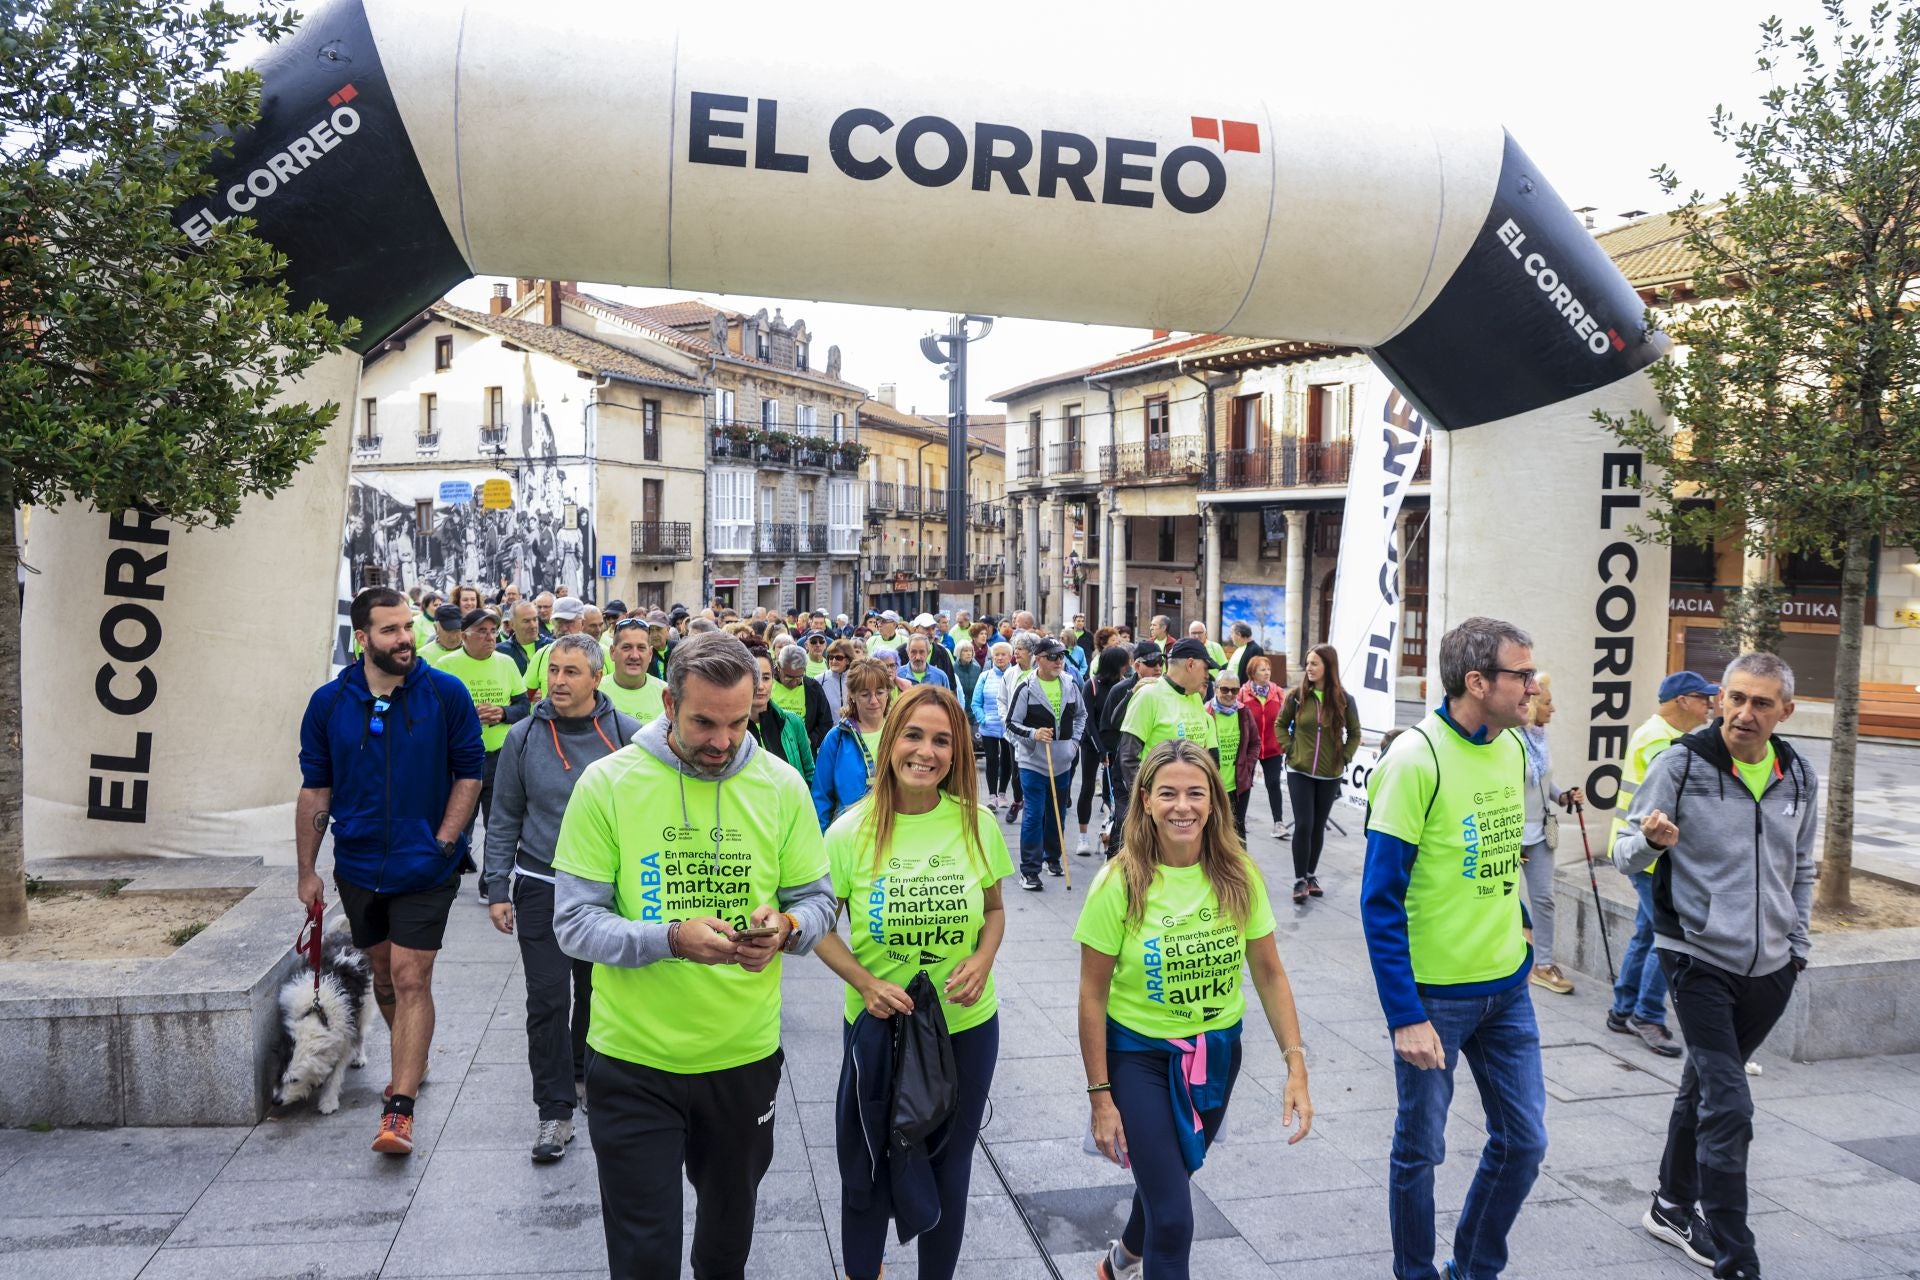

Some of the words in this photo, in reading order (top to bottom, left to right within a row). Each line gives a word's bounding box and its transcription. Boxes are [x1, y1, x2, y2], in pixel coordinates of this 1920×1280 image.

[689, 91, 809, 174] EL
[829, 107, 1227, 214] CORREO
[180, 207, 233, 247] EL
[227, 107, 361, 212] CORREO
[1496, 218, 1524, 261] EL
[1523, 252, 1611, 355] CORREO
[1600, 452, 1643, 530] EL
[1776, 601, 1838, 617] OTIKA
[1363, 621, 1396, 694] EL
[1585, 541, 1639, 811] CORREO
[86, 731, 153, 823] EL
[1479, 818, 1491, 832] el
[665, 850, 678, 859] En
[679, 850, 717, 859] marcha
[719, 852, 752, 861] contra
[1462, 814, 1479, 879] ARABA
[665, 860, 682, 876] el
[686, 861, 752, 877] cáncer
[890, 876, 901, 884] En
[902, 875, 935, 883] marcha
[937, 873, 964, 882] contra
[640, 851, 662, 924] RABA
[666, 877, 750, 894] martxan
[889, 885, 905, 897] el
[909, 883, 965, 895] cáncer
[666, 896, 749, 910] minbiziaren
[869, 877, 887, 945] ARABA
[889, 897, 968, 913] martxan
[887, 914, 969, 927] minbiziaren
[889, 926, 965, 946] aurka
[1164, 934, 1175, 943] En
[1177, 931, 1210, 941] marcha
[1211, 924, 1237, 936] contra
[1165, 943, 1182, 958] el
[1186, 934, 1239, 954] cáncer
[1144, 937, 1165, 1004] ARABA
[1166, 949, 1241, 972] martxan
[1167, 964, 1240, 983] minbiziaren
[1169, 976, 1234, 1005] aurka
